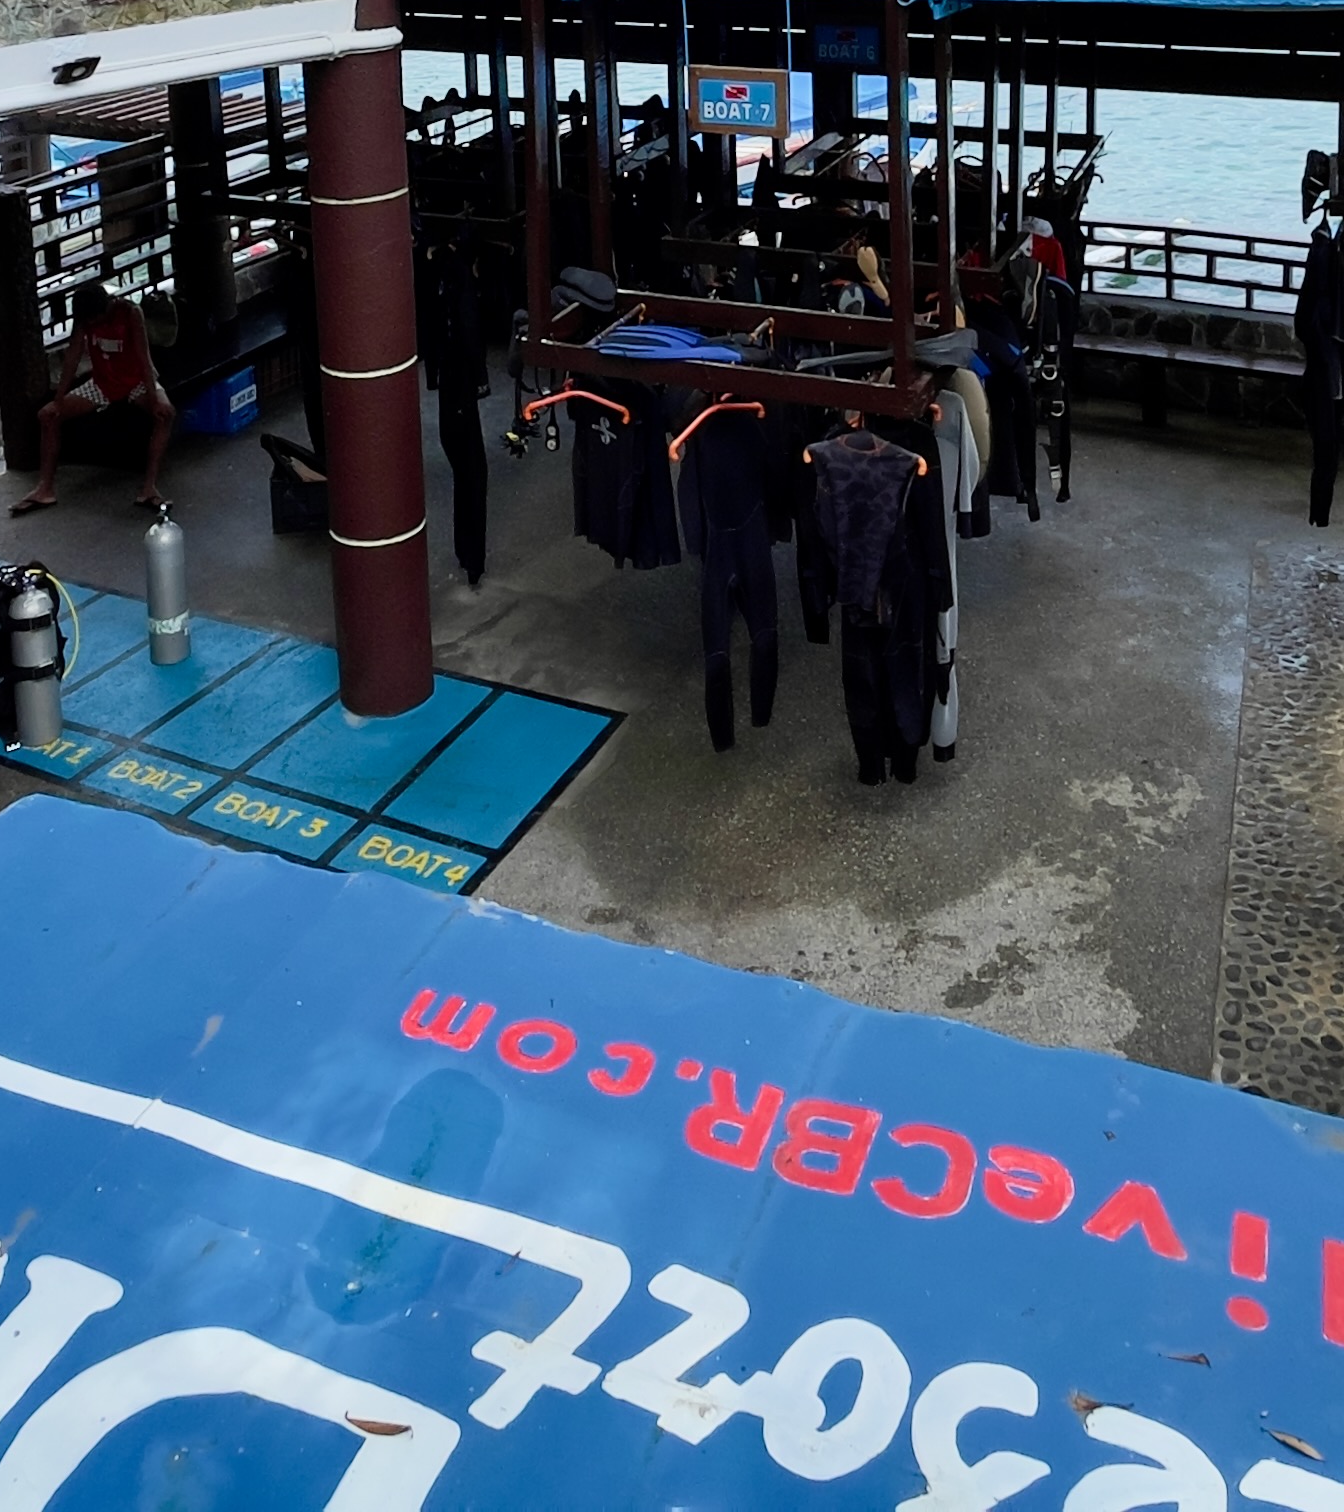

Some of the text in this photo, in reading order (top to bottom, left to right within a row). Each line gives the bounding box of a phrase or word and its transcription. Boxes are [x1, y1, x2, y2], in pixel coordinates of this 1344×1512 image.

[818, 43, 860, 59] BOAT
[703, 101, 771, 122] BOAT 7
[213, 792, 330, 839] BOAT 3
